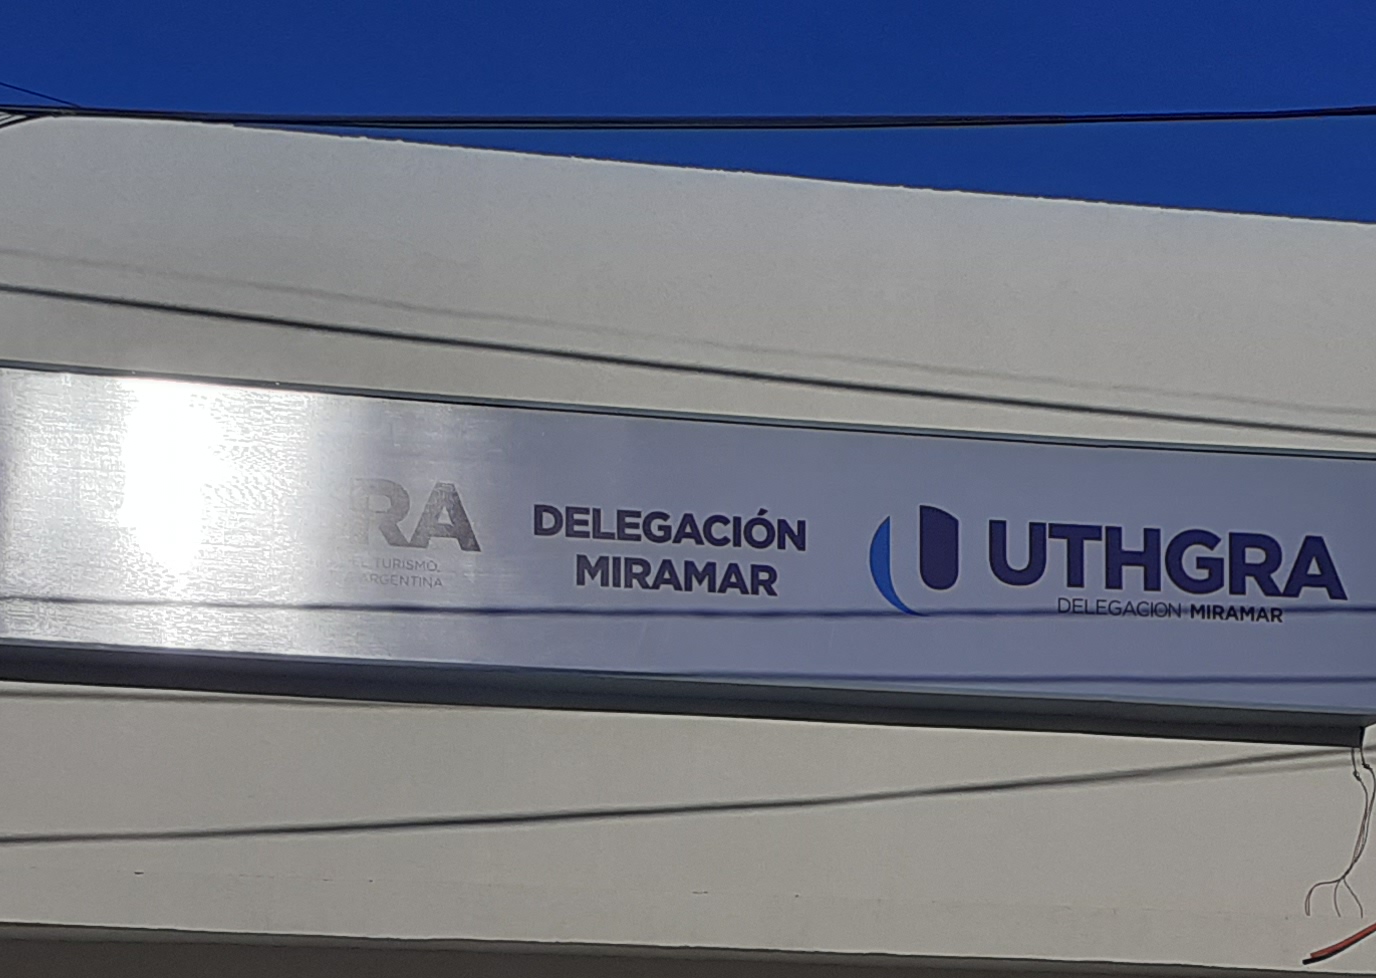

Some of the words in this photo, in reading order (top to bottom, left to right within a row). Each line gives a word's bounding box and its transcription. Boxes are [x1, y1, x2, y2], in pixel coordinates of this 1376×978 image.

[533, 503, 807, 551] DELEGACIÓN
[575, 553, 779, 597] MIRAMAR
[988, 519, 1349, 601] UTHGRA
[1057, 597, 1182, 618] DELEGACION
[1190, 604, 1284, 623] MIRAMAR
